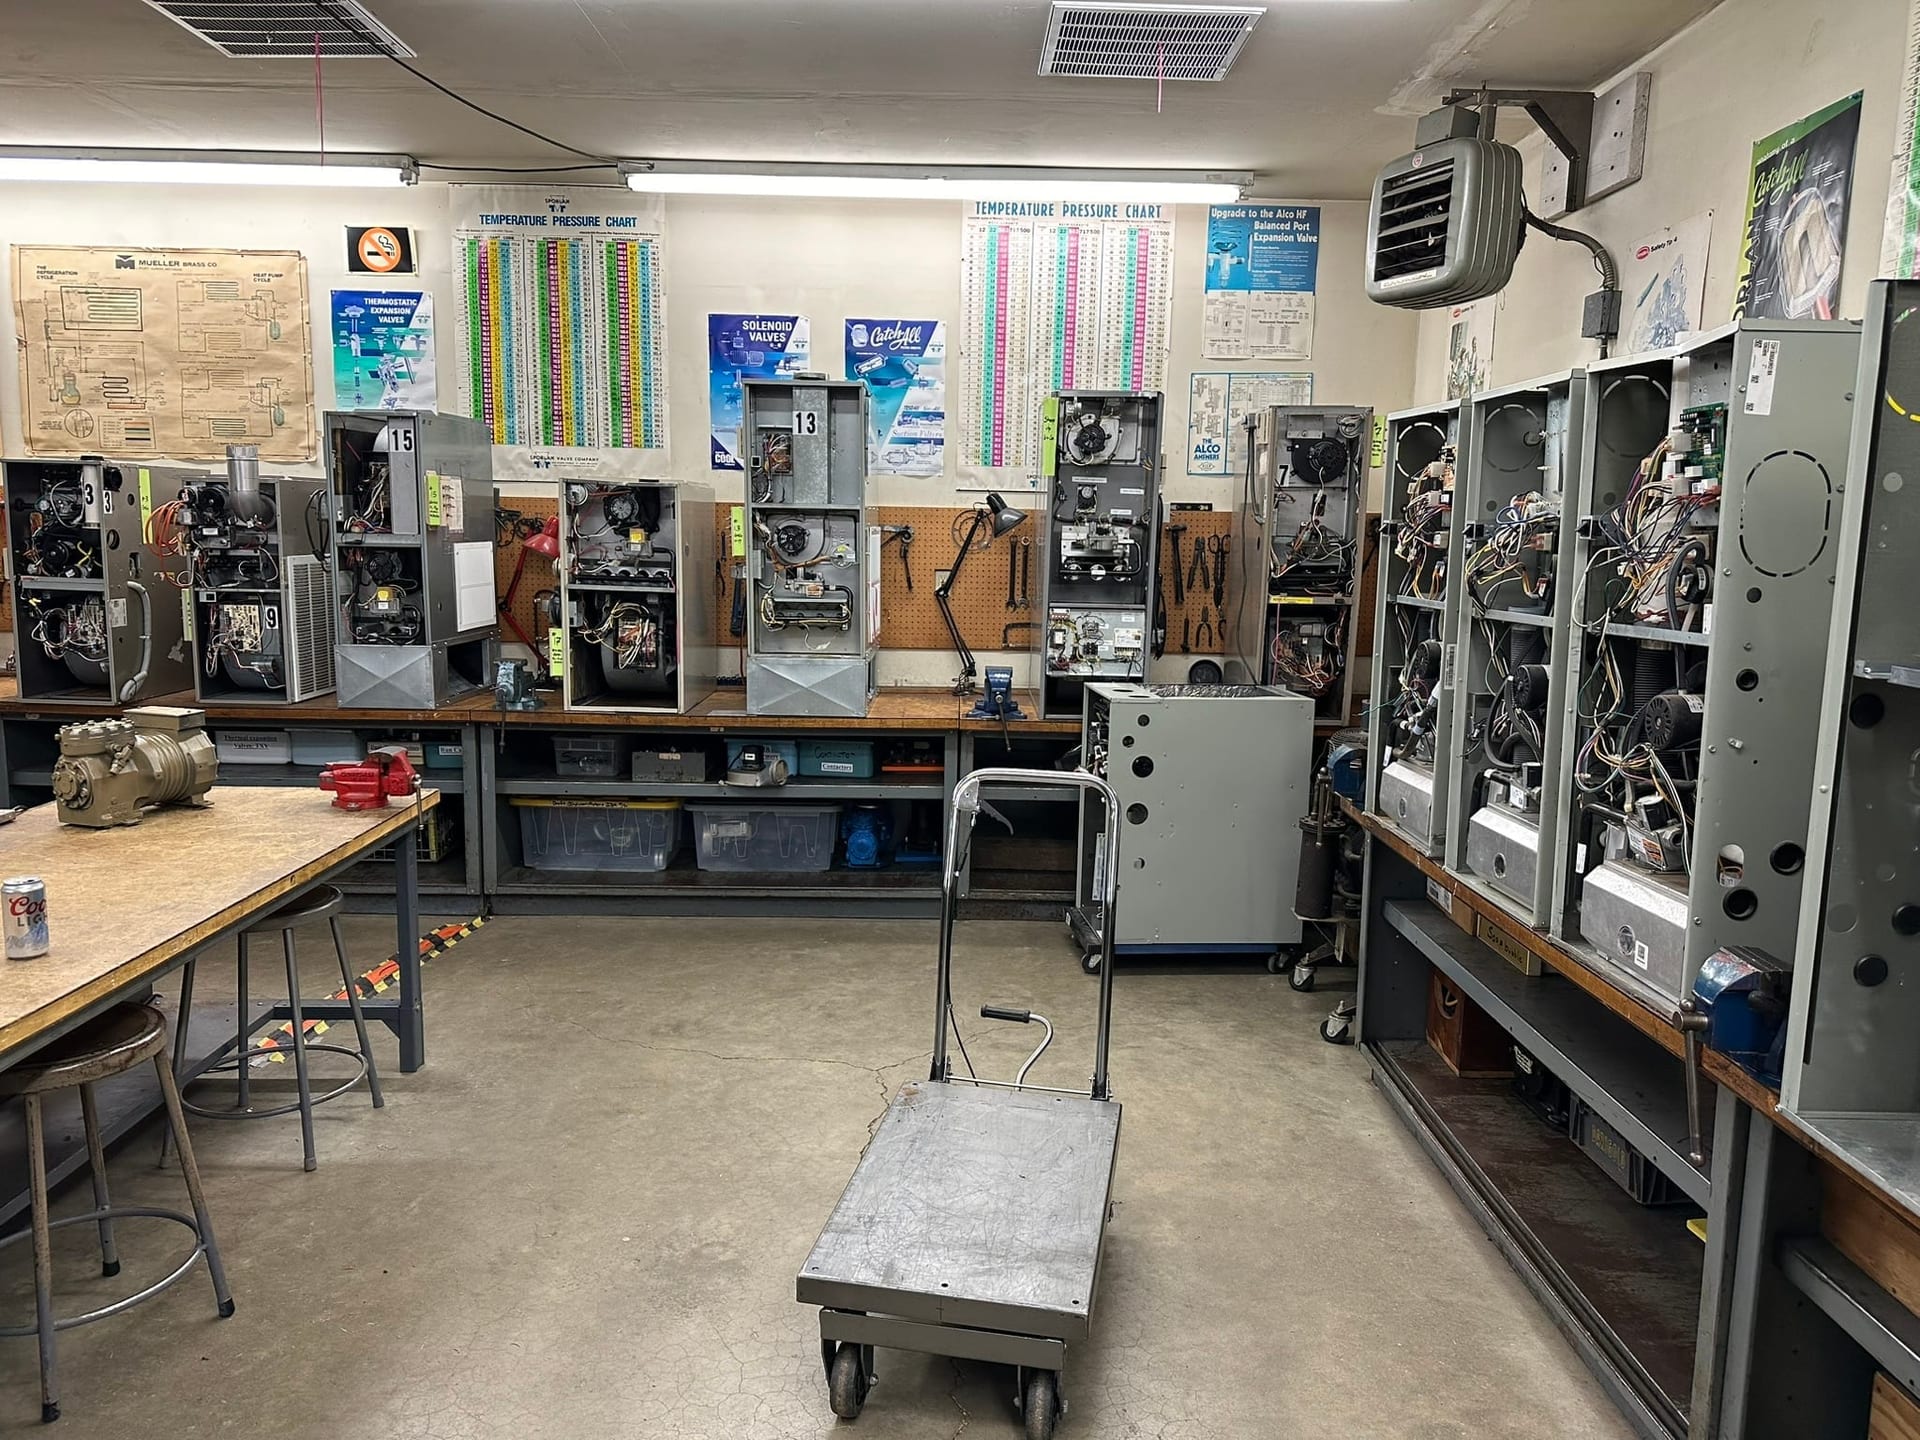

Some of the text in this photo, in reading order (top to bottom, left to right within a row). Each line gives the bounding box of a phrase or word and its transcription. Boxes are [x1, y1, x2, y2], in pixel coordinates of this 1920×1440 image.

[976, 201, 1162, 218] TEMPERATURE PRESSURE CHART
[1211, 208, 1308, 219] Upgrade to the Alco HF
[479, 214, 637, 227] TEMPERATURE PRESSURE CHART
[1254, 221, 1310, 231] Balanced Port
[1254, 233, 1318, 243] Expansion Valve
[364, 298, 417, 306] THERMOSTATIC
[378, 316, 405, 324] VALVES
[742, 320, 793, 331] SOLENOID
[749, 332, 786, 342] VALVES
[796, 412, 817, 434] 13
[392, 429, 414, 452] 15
[1194, 444, 1220, 453] ALCO
[1279, 465, 1289, 486] 7
[85, 483, 94, 505] 3
[104, 492, 111, 512] 3
[266, 608, 277, 628] 9
